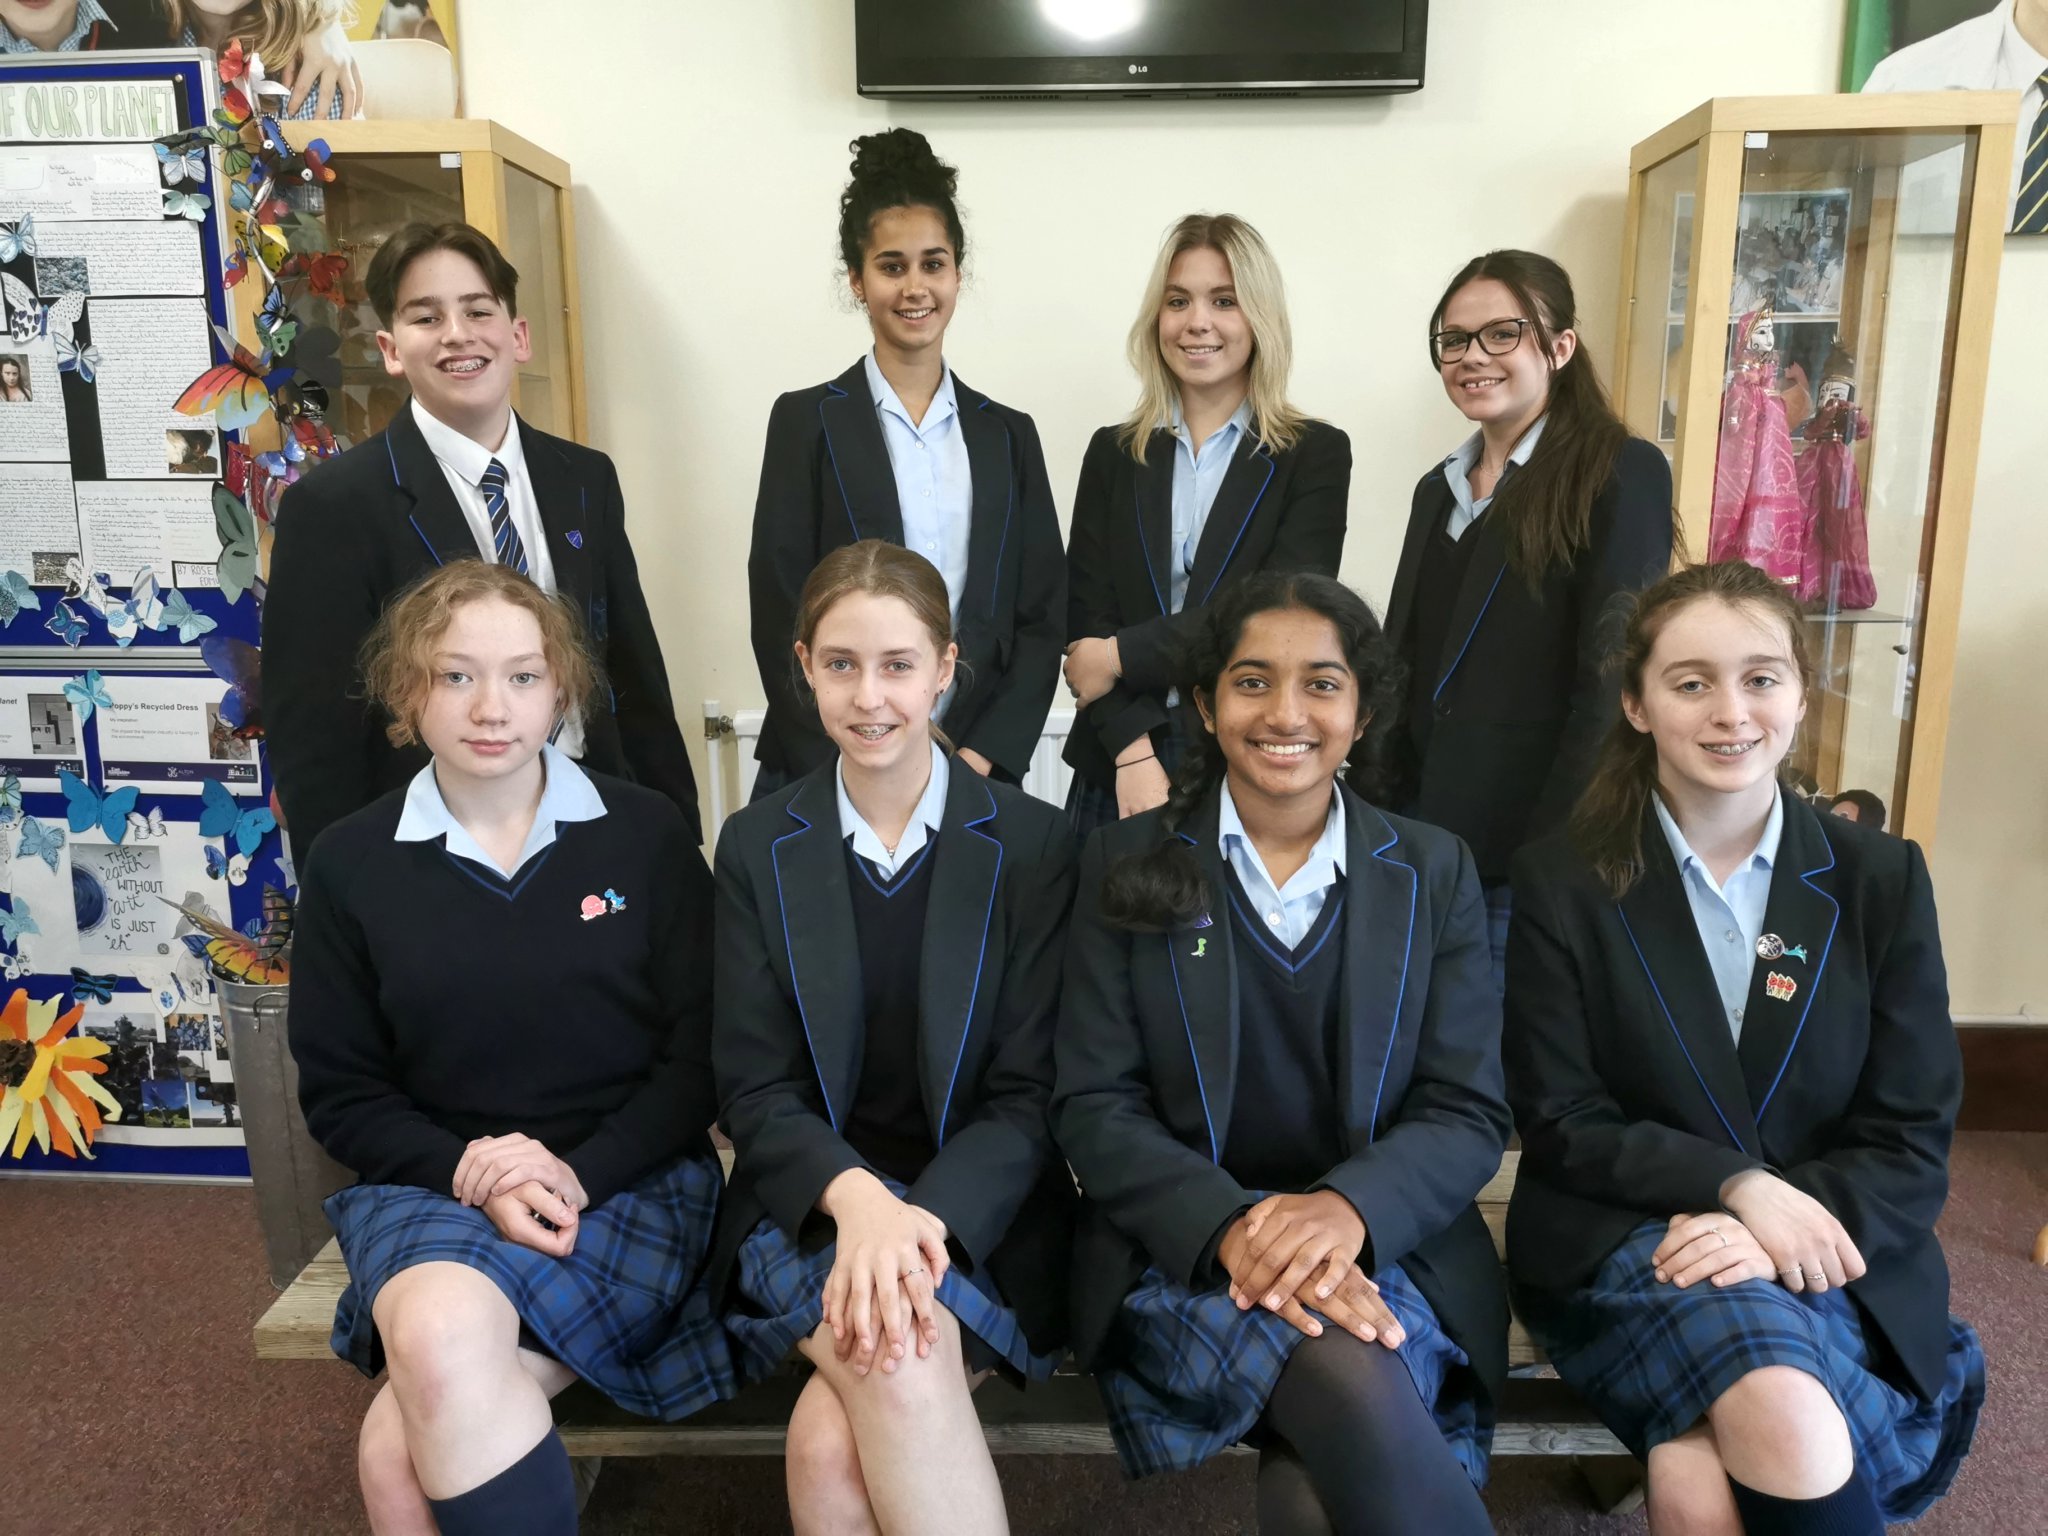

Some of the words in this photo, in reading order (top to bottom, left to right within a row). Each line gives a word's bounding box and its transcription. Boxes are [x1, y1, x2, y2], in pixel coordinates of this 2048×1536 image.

[0, 86, 16, 137] F
[24, 85, 82, 138] OUR
[83, 85, 174, 138] PLANET
[176, 564, 187, 575] BY
[190, 565, 213, 576] ROSE
[199, 576, 220, 586] EDMU
[140, 703, 175, 711] Recycled
[176, 703, 199, 711] Dress
[104, 846, 133, 863] THE
[117, 879, 164, 894] WITHOUT
[111, 918, 121, 930] IS
[127, 919, 156, 933] JUST
